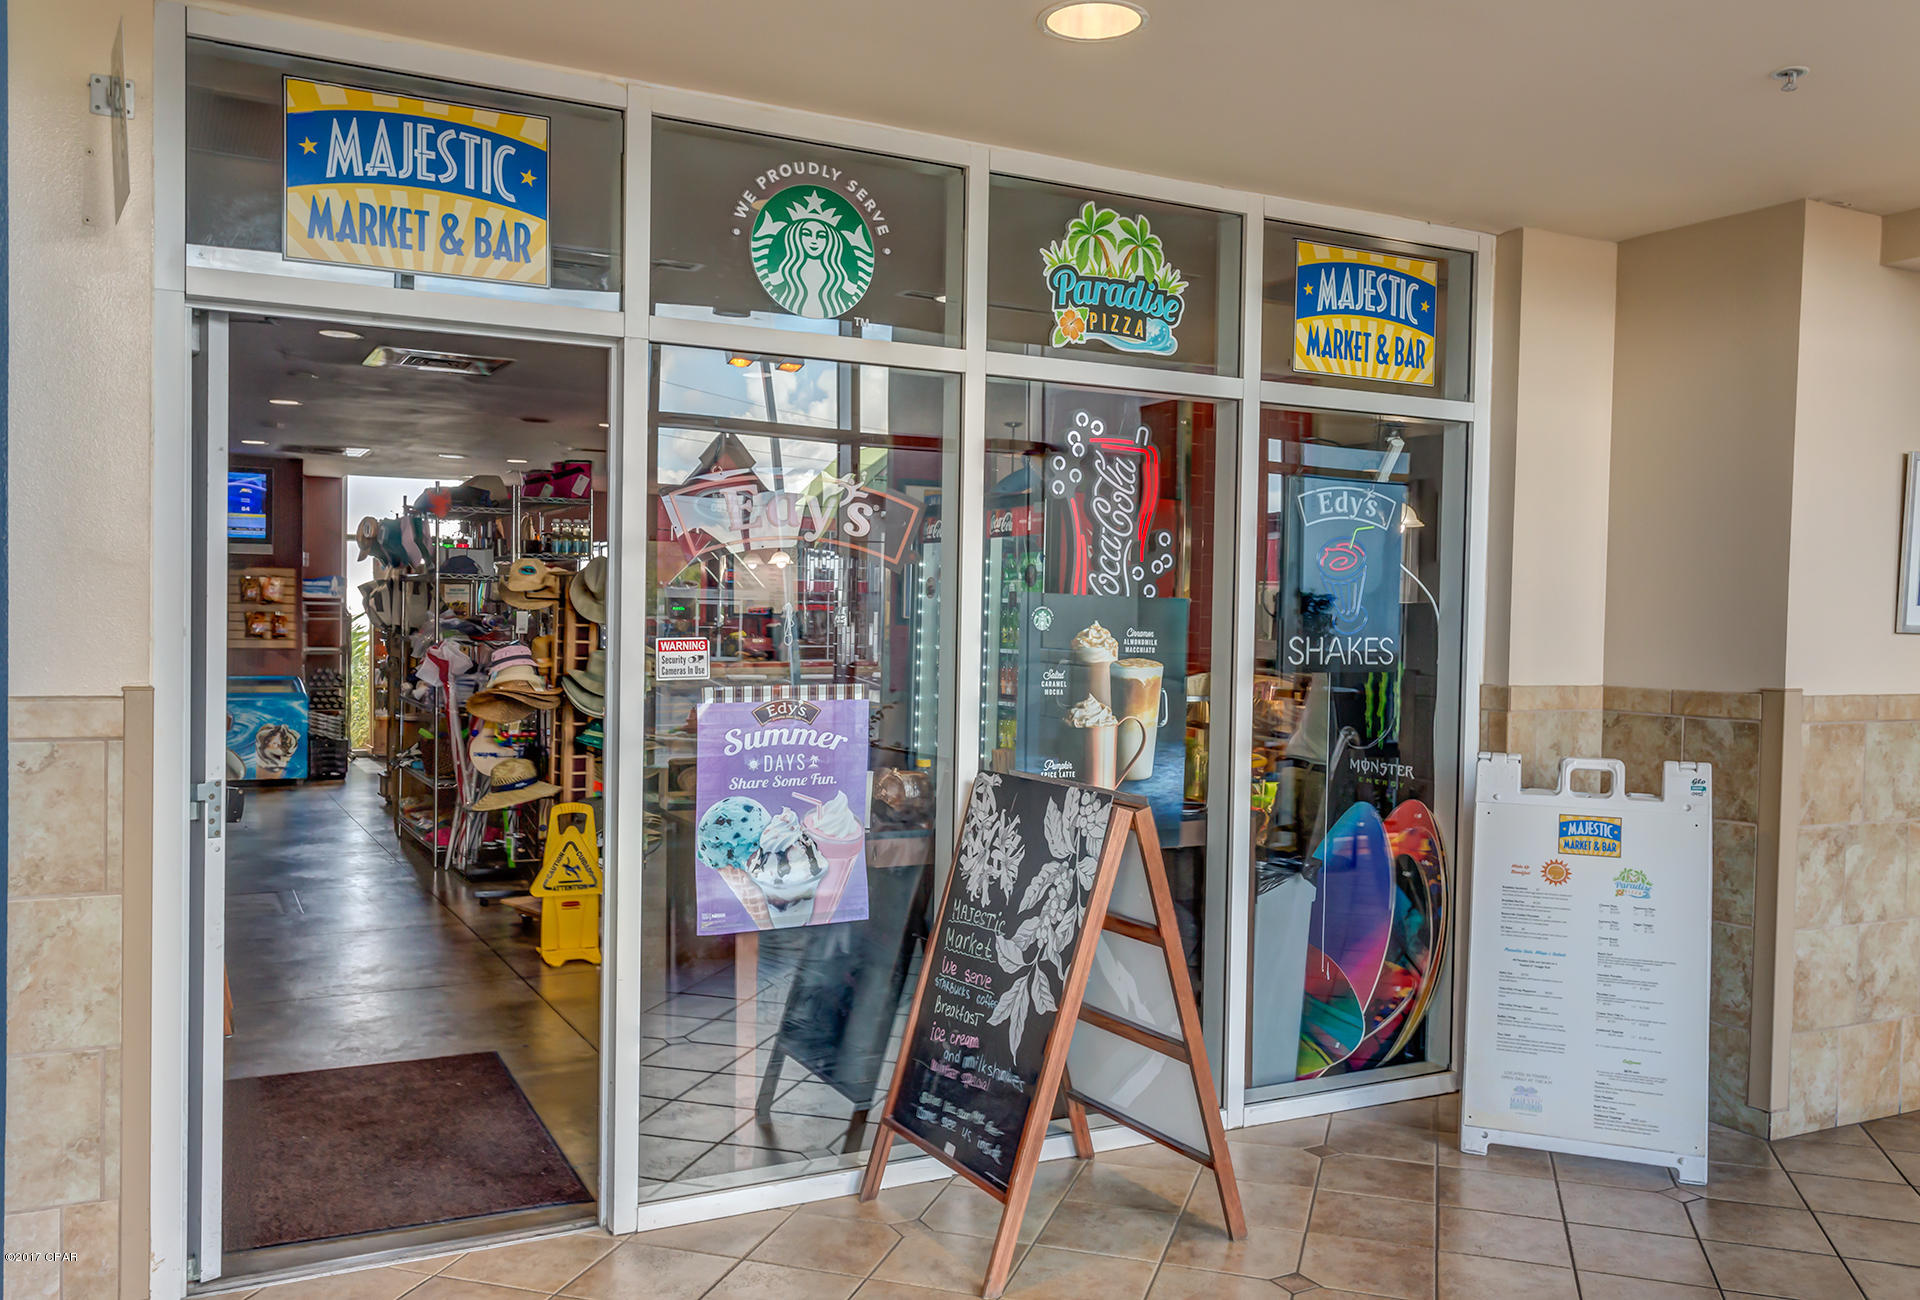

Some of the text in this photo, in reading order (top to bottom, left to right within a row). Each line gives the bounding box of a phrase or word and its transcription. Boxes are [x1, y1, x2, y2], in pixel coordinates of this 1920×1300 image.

[326, 117, 516, 202] MAJESTIC
[734, 161, 890, 236] WE PROUDLY SERVE
[307, 195, 531, 264] MARKET & BAR
[1052, 268, 1180, 322] Paradise
[1316, 267, 1420, 325] MAJESTIC
[1089, 312, 1144, 338] PIZZA
[1306, 324, 1425, 370] MARKET & BAR
[1316, 488, 1379, 521] Edy's
[660, 640, 706, 652] WARNING
[1287, 635, 1395, 666] SHAKES
[660, 666, 705, 675] Cameras In Use
[661, 655, 687, 666] Security
[1041, 680, 1067, 688] CARAMEL
[766, 700, 807, 718] Edy's
[724, 728, 848, 756] Summer
[763, 753, 805, 773] DAYS
[1350, 757, 1415, 779] MONSTER
[729, 772, 838, 790] Share Some Fun.
[1358, 776, 1404, 789] ENERGY
[1567, 821, 1613, 839] MAJESTIC
[1563, 839, 1617, 852] MARKET & BAR
[945, 927, 993, 958] Market
[942, 956, 993, 989] We serve
[930, 1021, 980, 1048] ice cream
[943, 1050, 961, 1063] and
